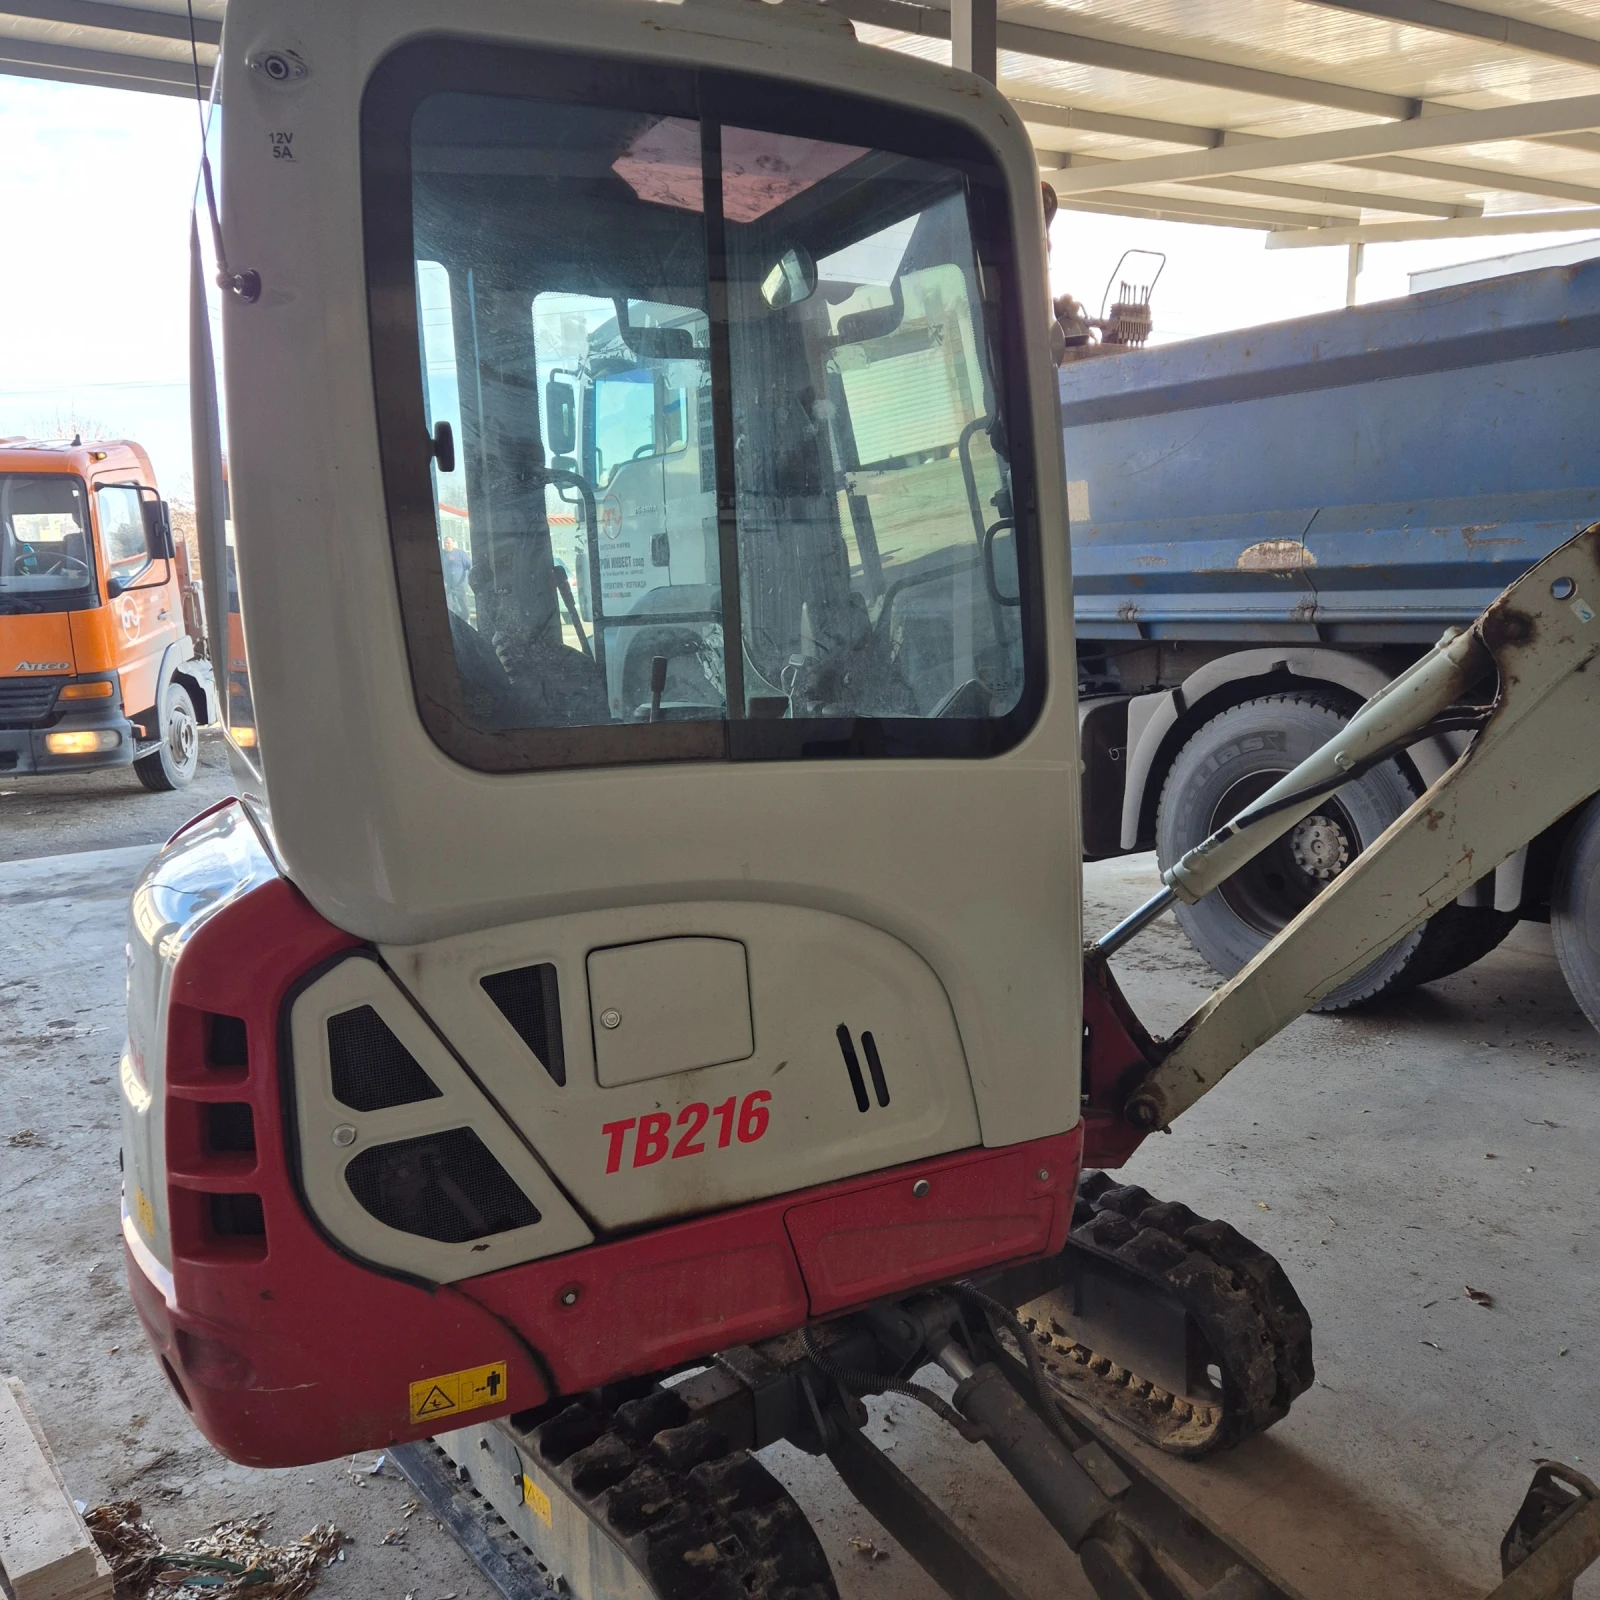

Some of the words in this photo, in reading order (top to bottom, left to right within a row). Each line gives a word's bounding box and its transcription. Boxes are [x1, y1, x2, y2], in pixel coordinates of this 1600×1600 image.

[269, 131, 293, 144] 12V
[272, 145, 293, 159] 5A
[600, 555, 611, 570] РОЙ
[14, 661, 70, 672] ATEGO
[602, 1090, 772, 1174] TB216
